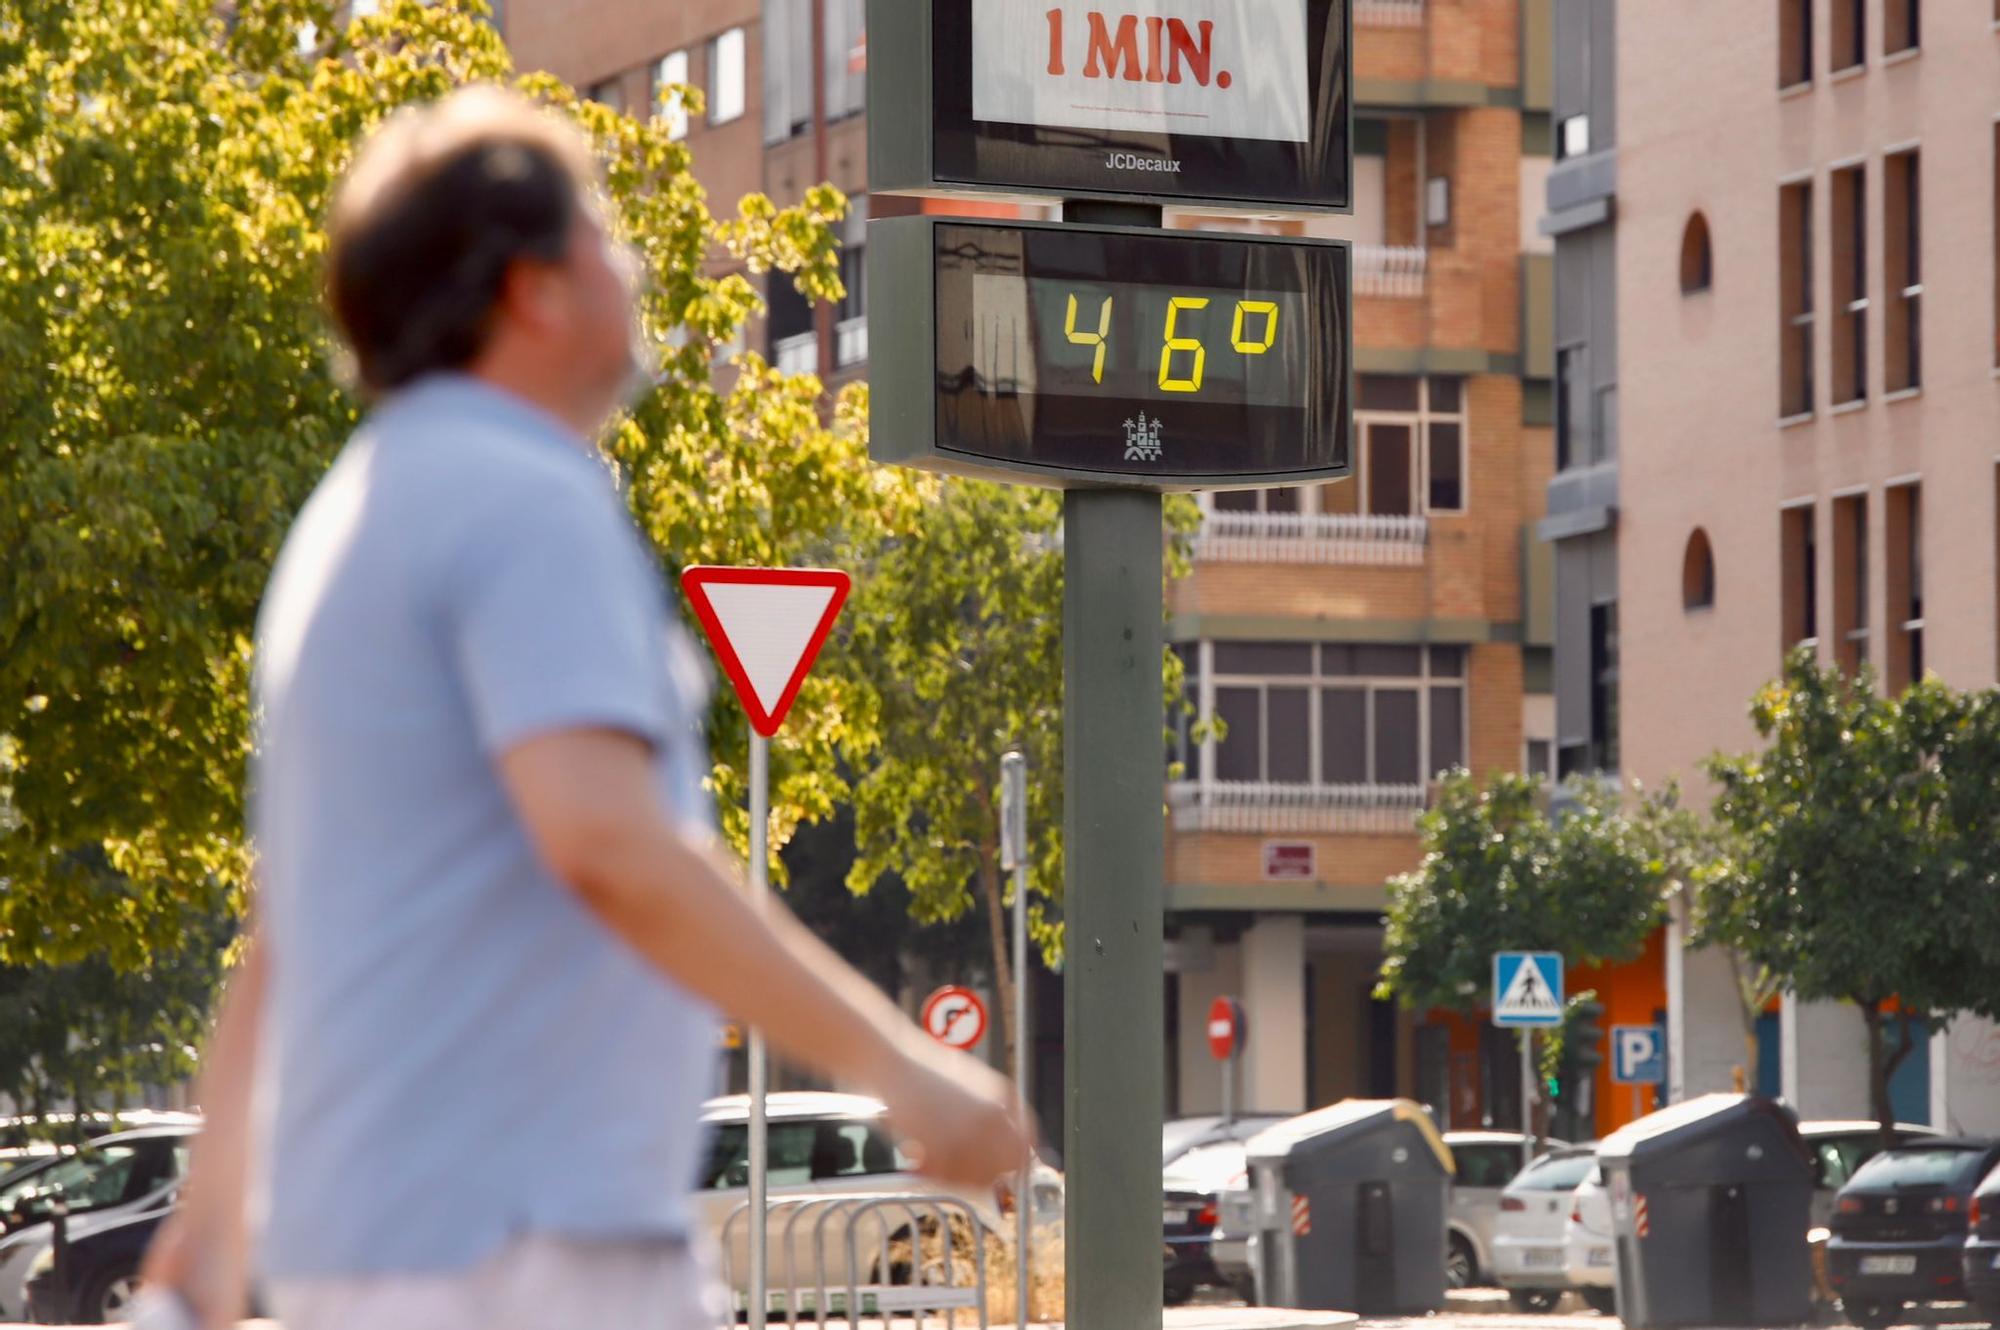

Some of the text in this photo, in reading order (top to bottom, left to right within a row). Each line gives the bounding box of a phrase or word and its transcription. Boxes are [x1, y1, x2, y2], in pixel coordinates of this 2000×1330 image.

[1046, 8, 1232, 90] 1 MIN.
[1105, 152, 1181, 173] JCDecaux
[1622, 1031, 1653, 1076] P
